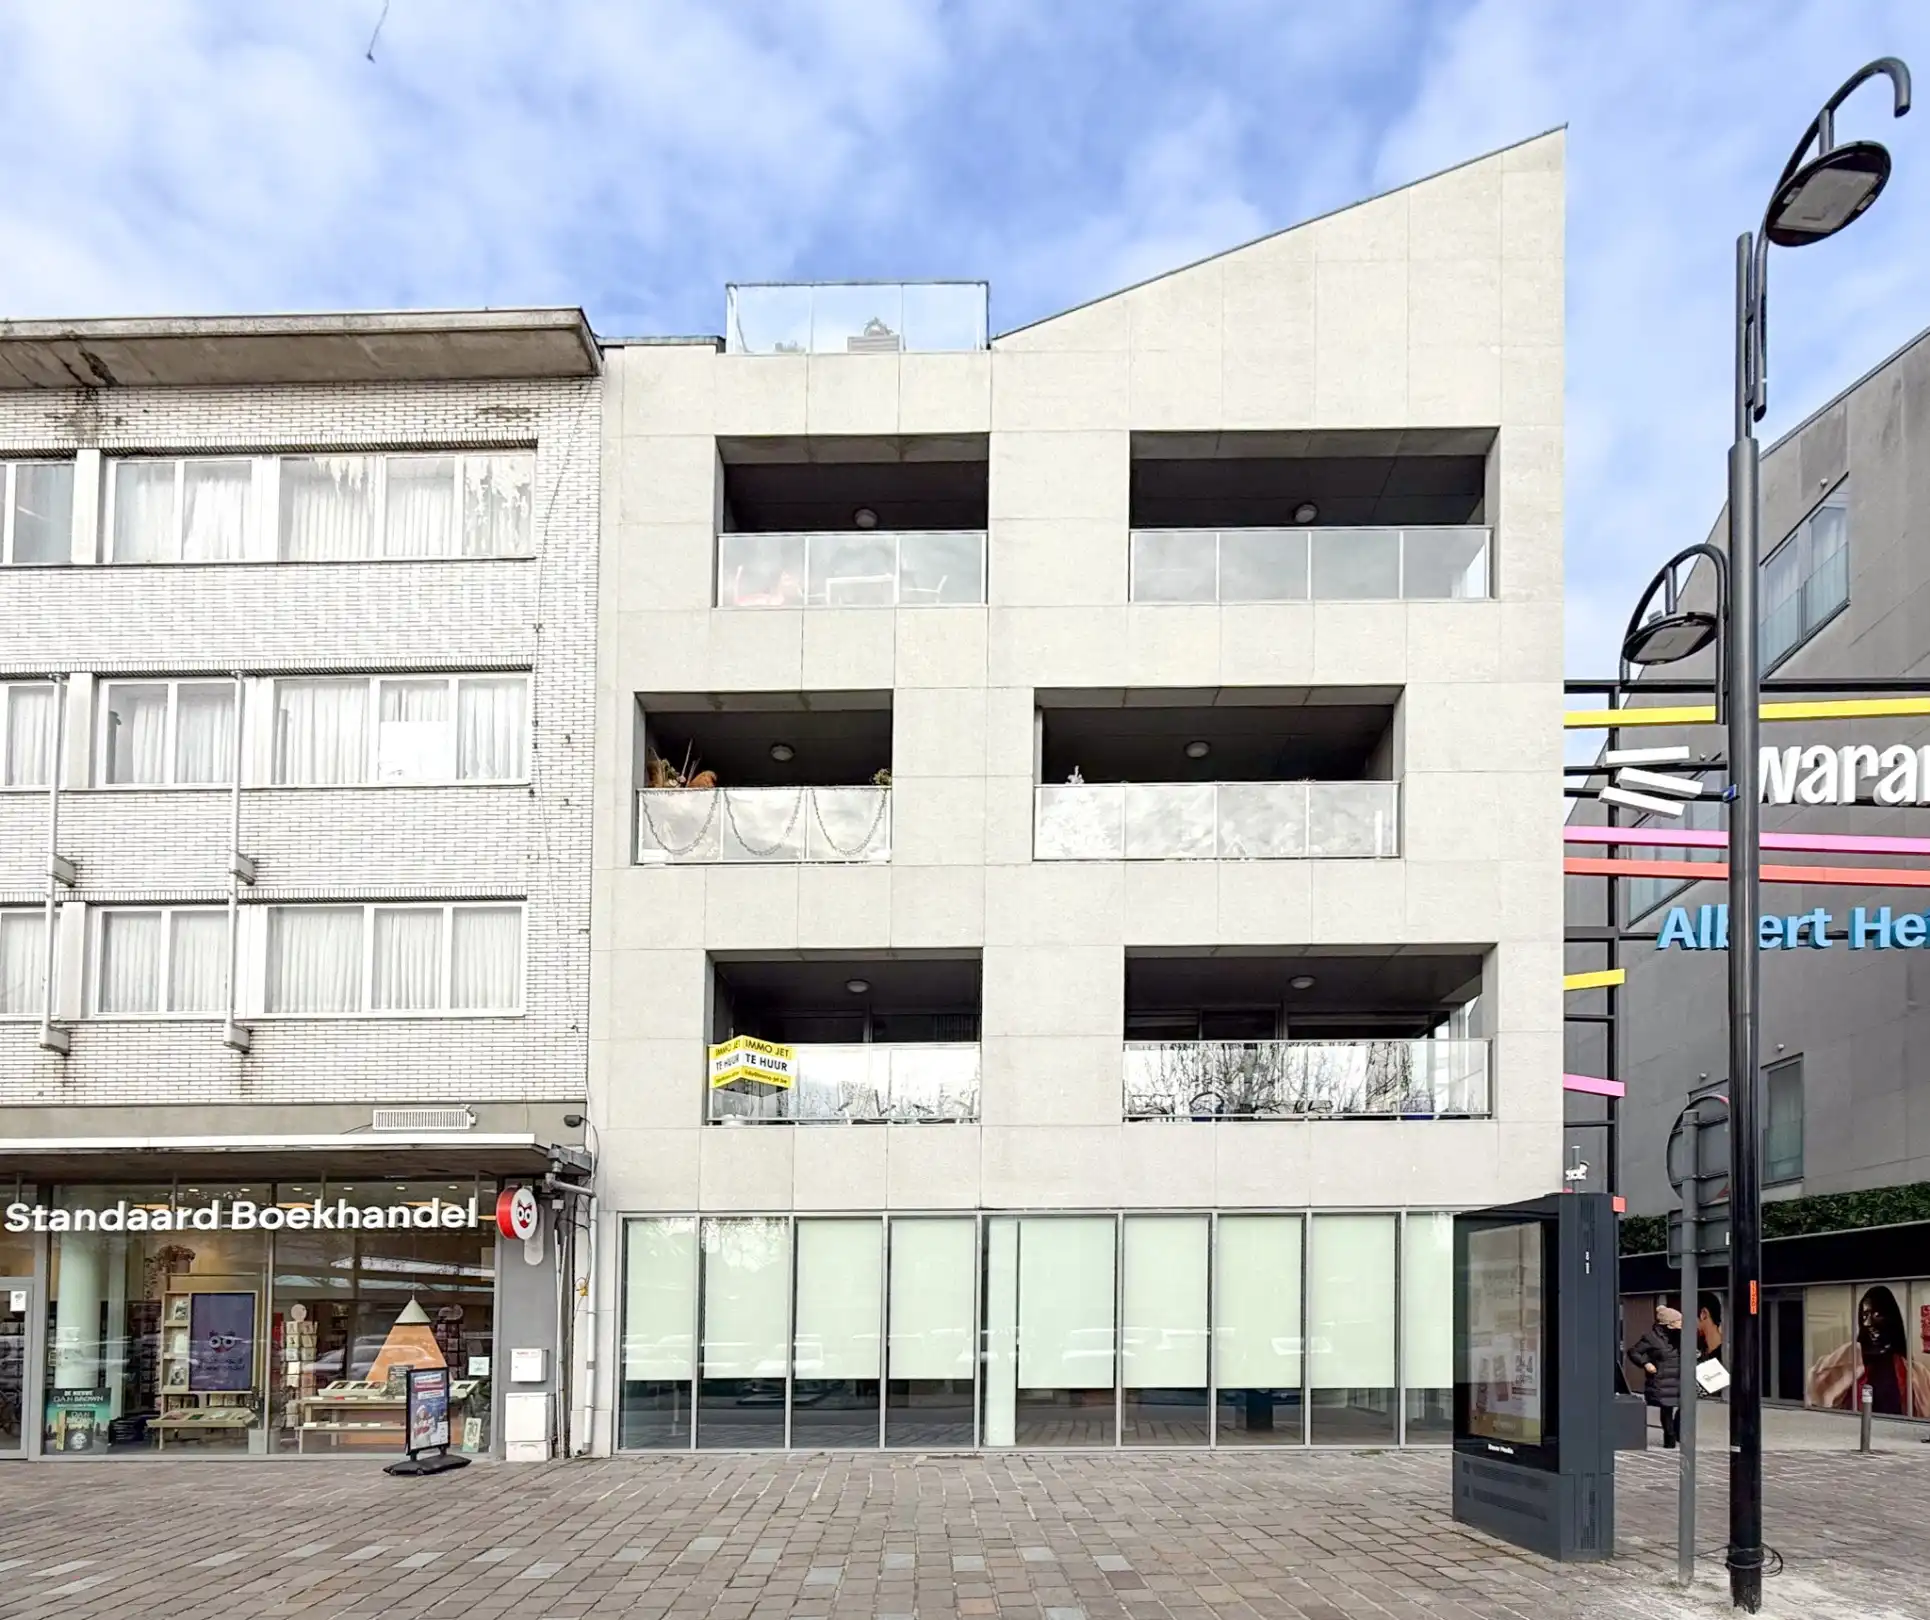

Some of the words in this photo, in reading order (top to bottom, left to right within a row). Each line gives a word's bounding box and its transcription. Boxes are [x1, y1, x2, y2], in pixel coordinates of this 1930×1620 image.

[745, 1039, 773, 1054] IMMO
[775, 1048, 789, 1058] JET
[745, 1053, 757, 1065] TE
[759, 1057, 788, 1072] HUUR
[4, 1200, 220, 1232] Standaard
[231, 1198, 477, 1230] Boekhandel
